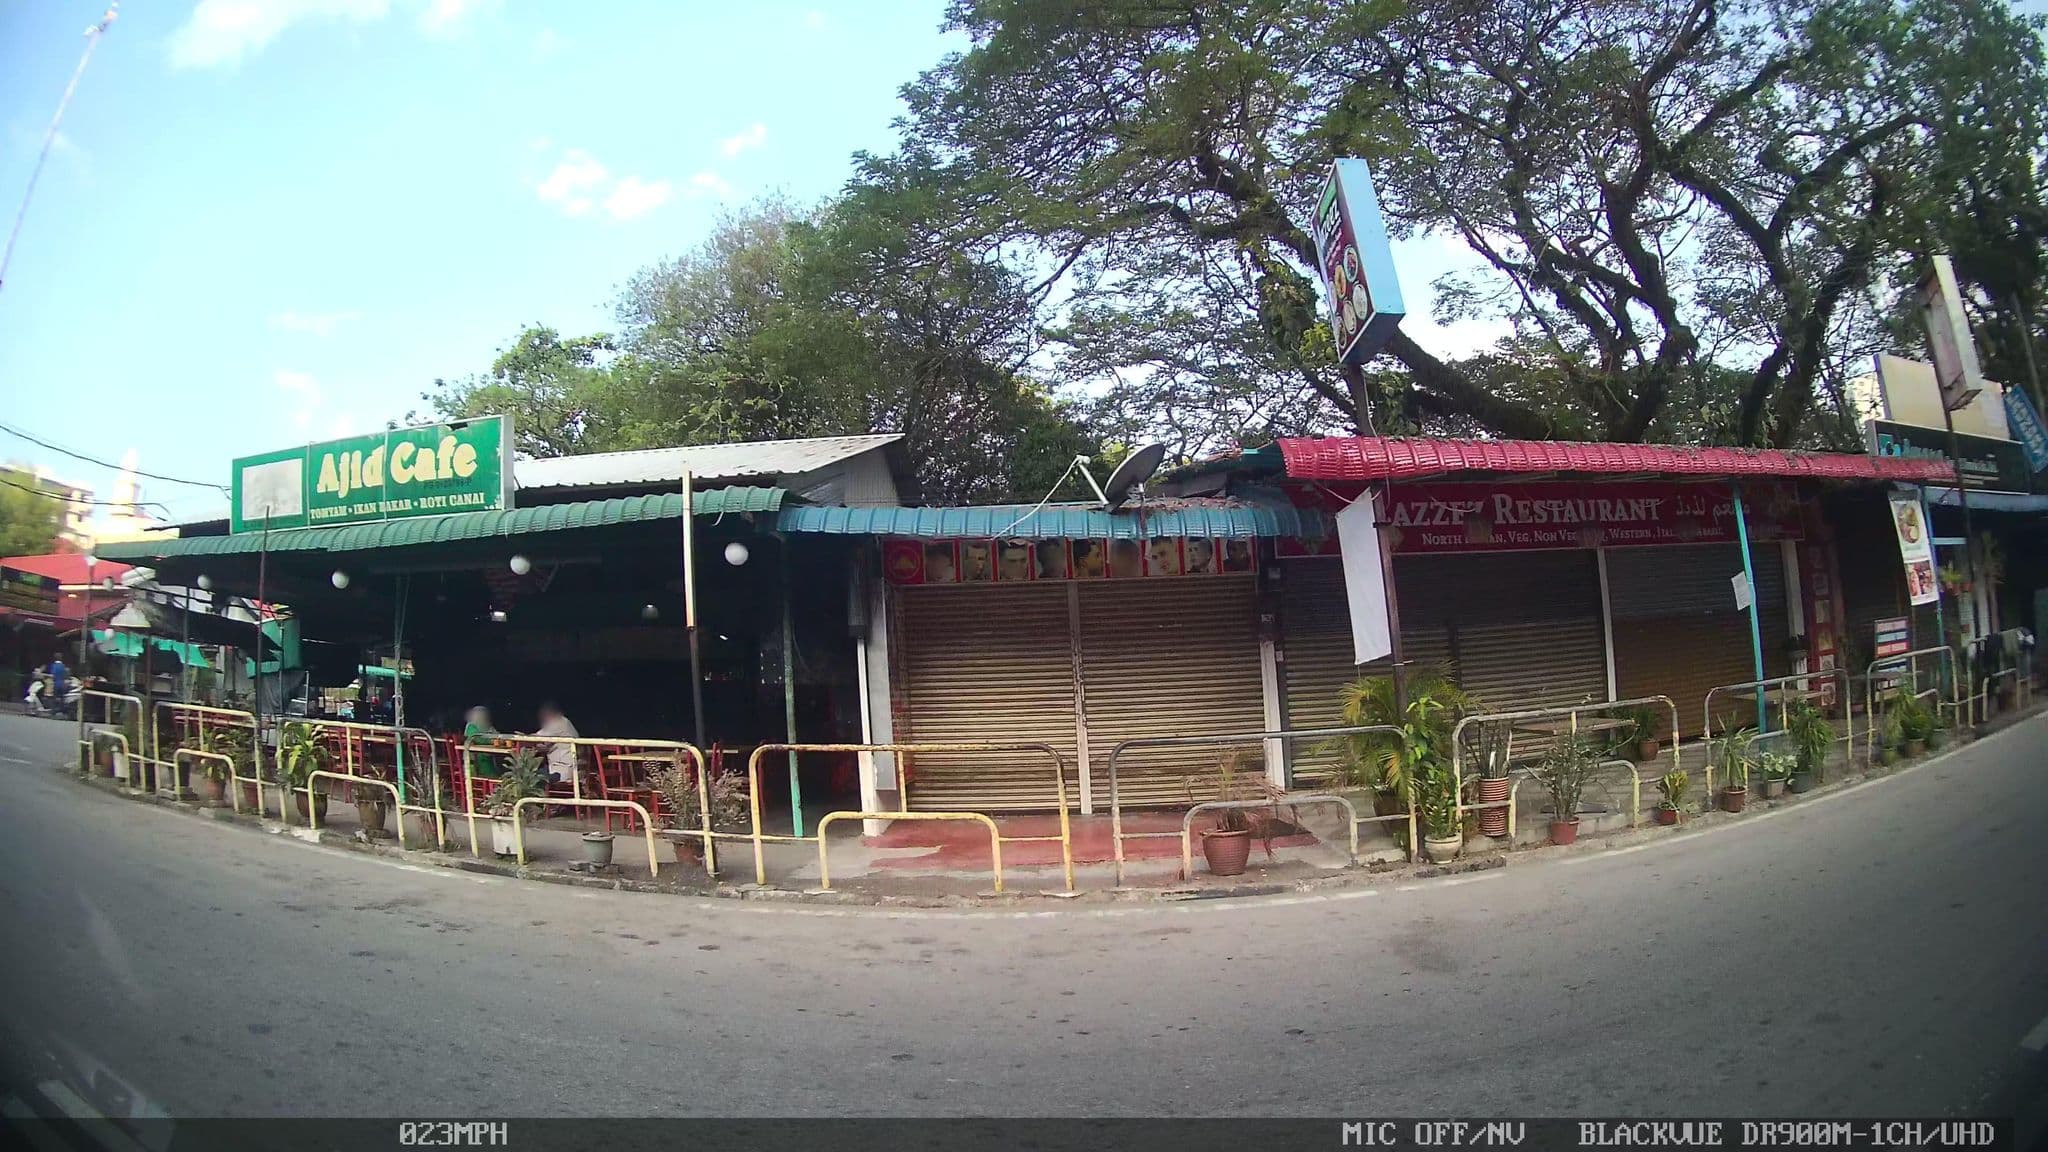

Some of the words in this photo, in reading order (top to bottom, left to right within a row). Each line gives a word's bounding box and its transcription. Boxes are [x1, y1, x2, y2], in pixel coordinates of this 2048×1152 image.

[317, 444, 385, 498] Ajid
[390, 435, 478, 484] Cafe
[353, 502, 377, 514] IKAN
[379, 499, 411, 513] BAKAR
[420, 495, 446, 508] ROTI
[450, 492, 485, 505] CANAI
